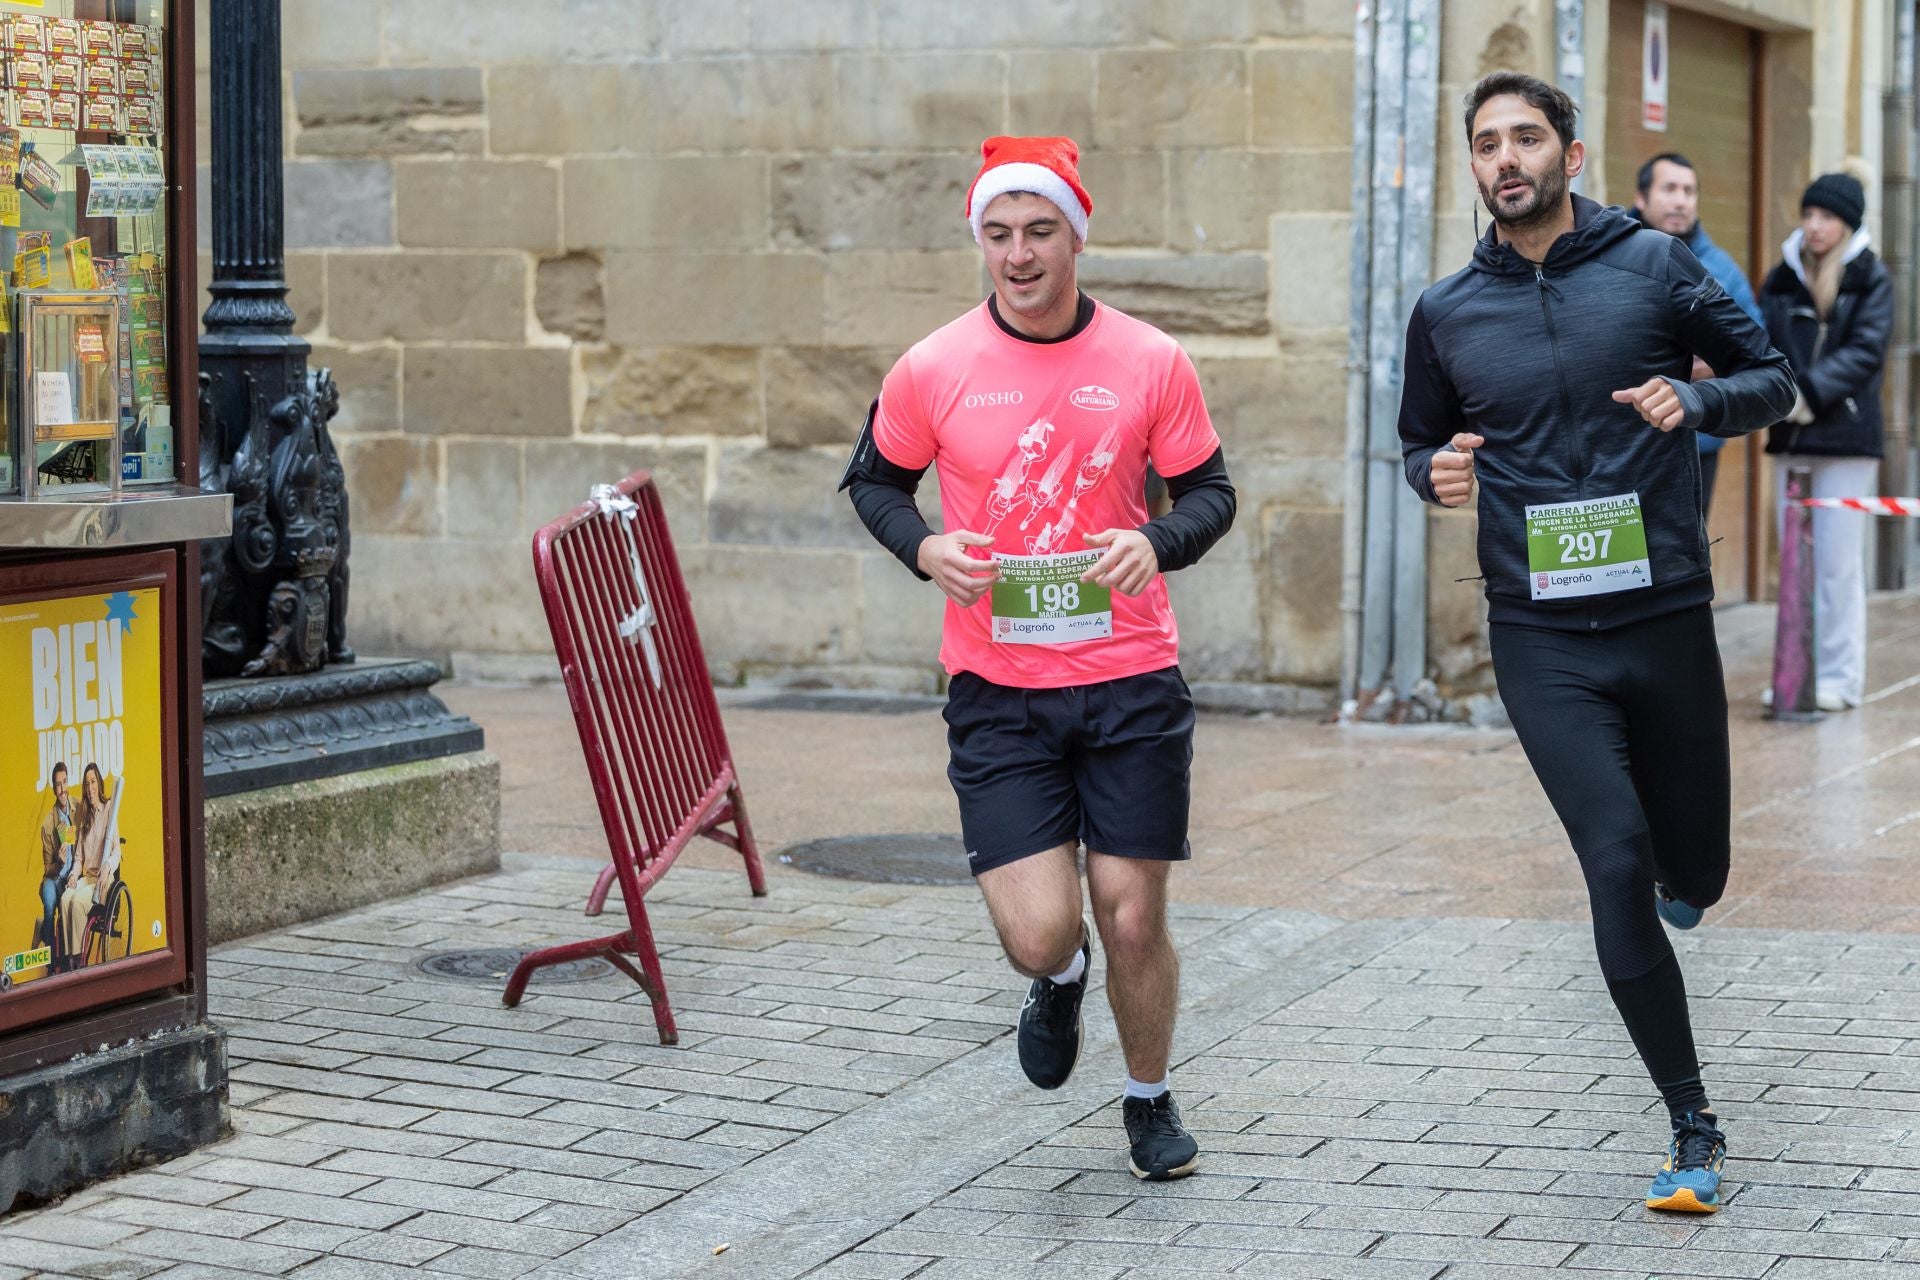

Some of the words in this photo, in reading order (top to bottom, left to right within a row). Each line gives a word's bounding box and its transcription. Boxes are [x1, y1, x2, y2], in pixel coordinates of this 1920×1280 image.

[965, 390, 1023, 408] OYSHO
[1530, 506, 1580, 519] CARRERA
[1584, 497, 1637, 513] POPULAR
[1533, 518, 1561, 527] VIRGEN
[1588, 508, 1636, 521] ESPERANZA
[1558, 529, 1612, 564] 297
[998, 567, 1028, 576] VIRGEN
[1551, 573, 1592, 586] Logroño
[1605, 568, 1630, 577] ACTUAL
[1024, 582, 1080, 613] 198
[1013, 622, 1055, 635] Logroño
[31, 617, 124, 731] BIEN
[36, 719, 124, 793] JUGADO
[25, 950, 49, 966] ONCE
